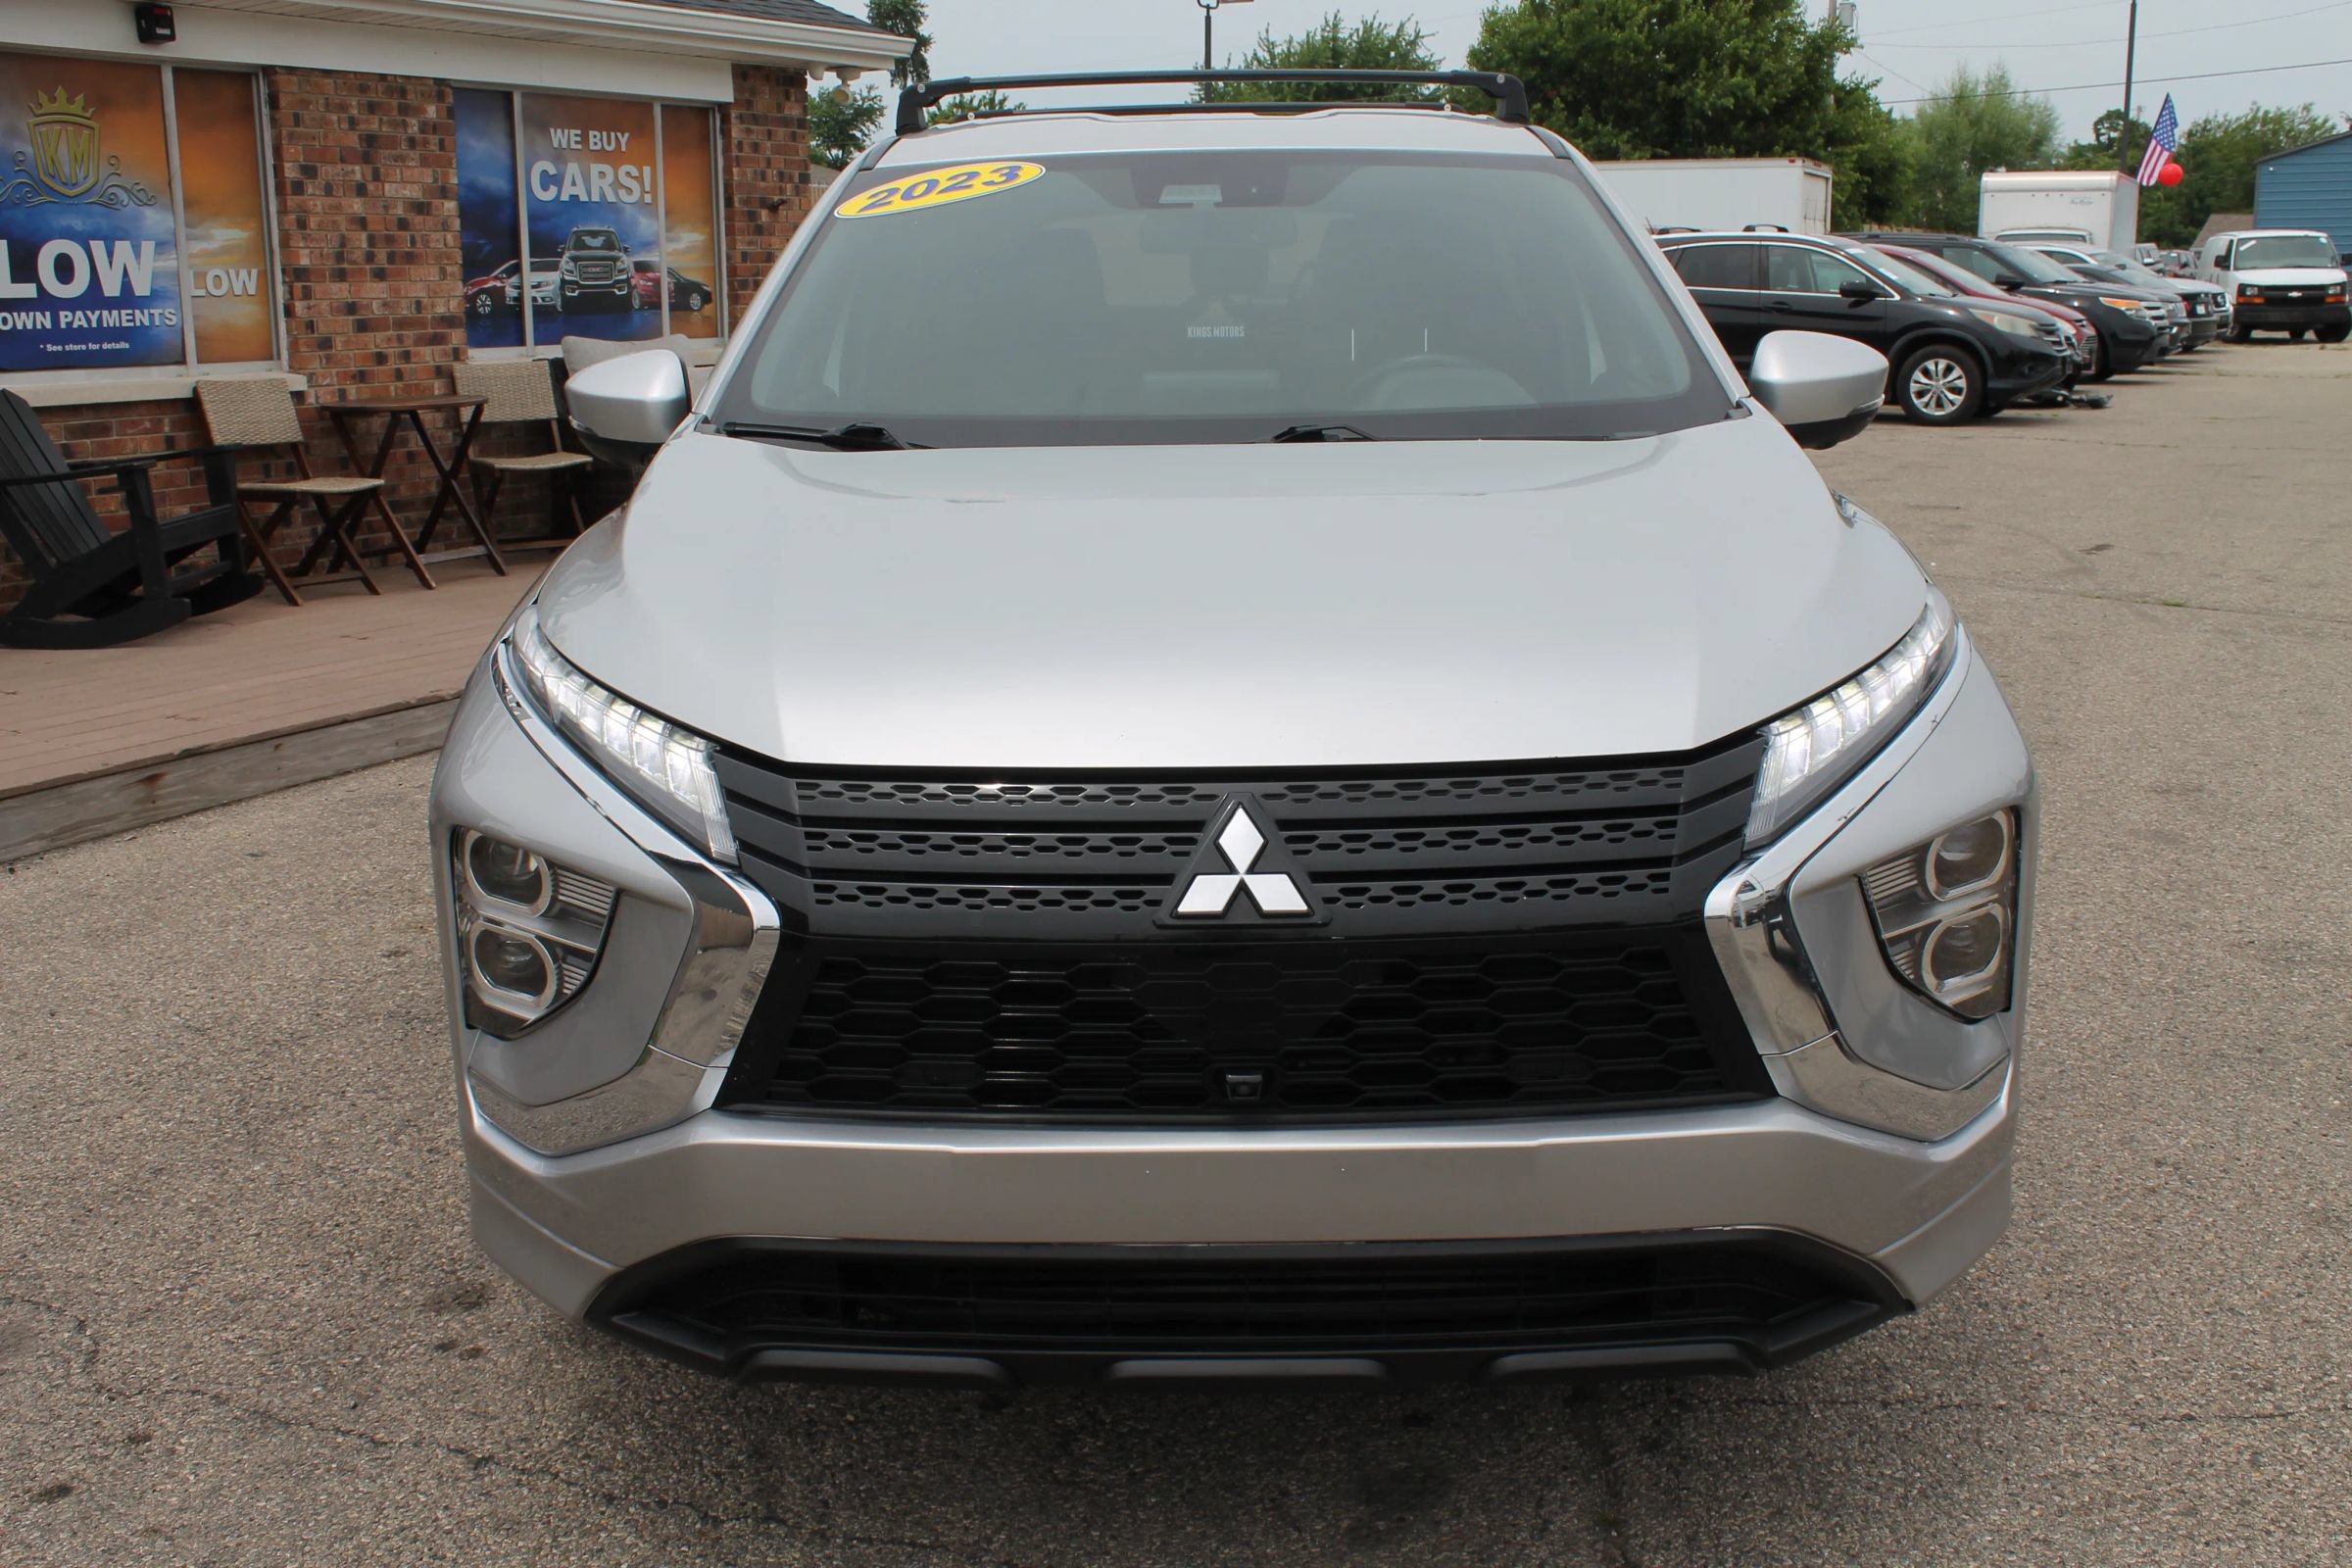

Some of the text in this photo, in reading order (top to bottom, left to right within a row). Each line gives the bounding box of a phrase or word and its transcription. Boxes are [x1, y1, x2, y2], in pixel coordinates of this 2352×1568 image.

[550, 127, 629, 152] WE BUY
[39, 126, 91, 185] KM
[530, 160, 652, 204] CARS!
[857, 165, 1024, 214] 2023
[0, 238, 156, 299] LOW
[188, 269, 258, 297] LOW
[59, 308, 177, 329] PAYMENTS
[1187, 325, 1245, 338] KINGS MOTORS
[102, 341, 130, 350] details
